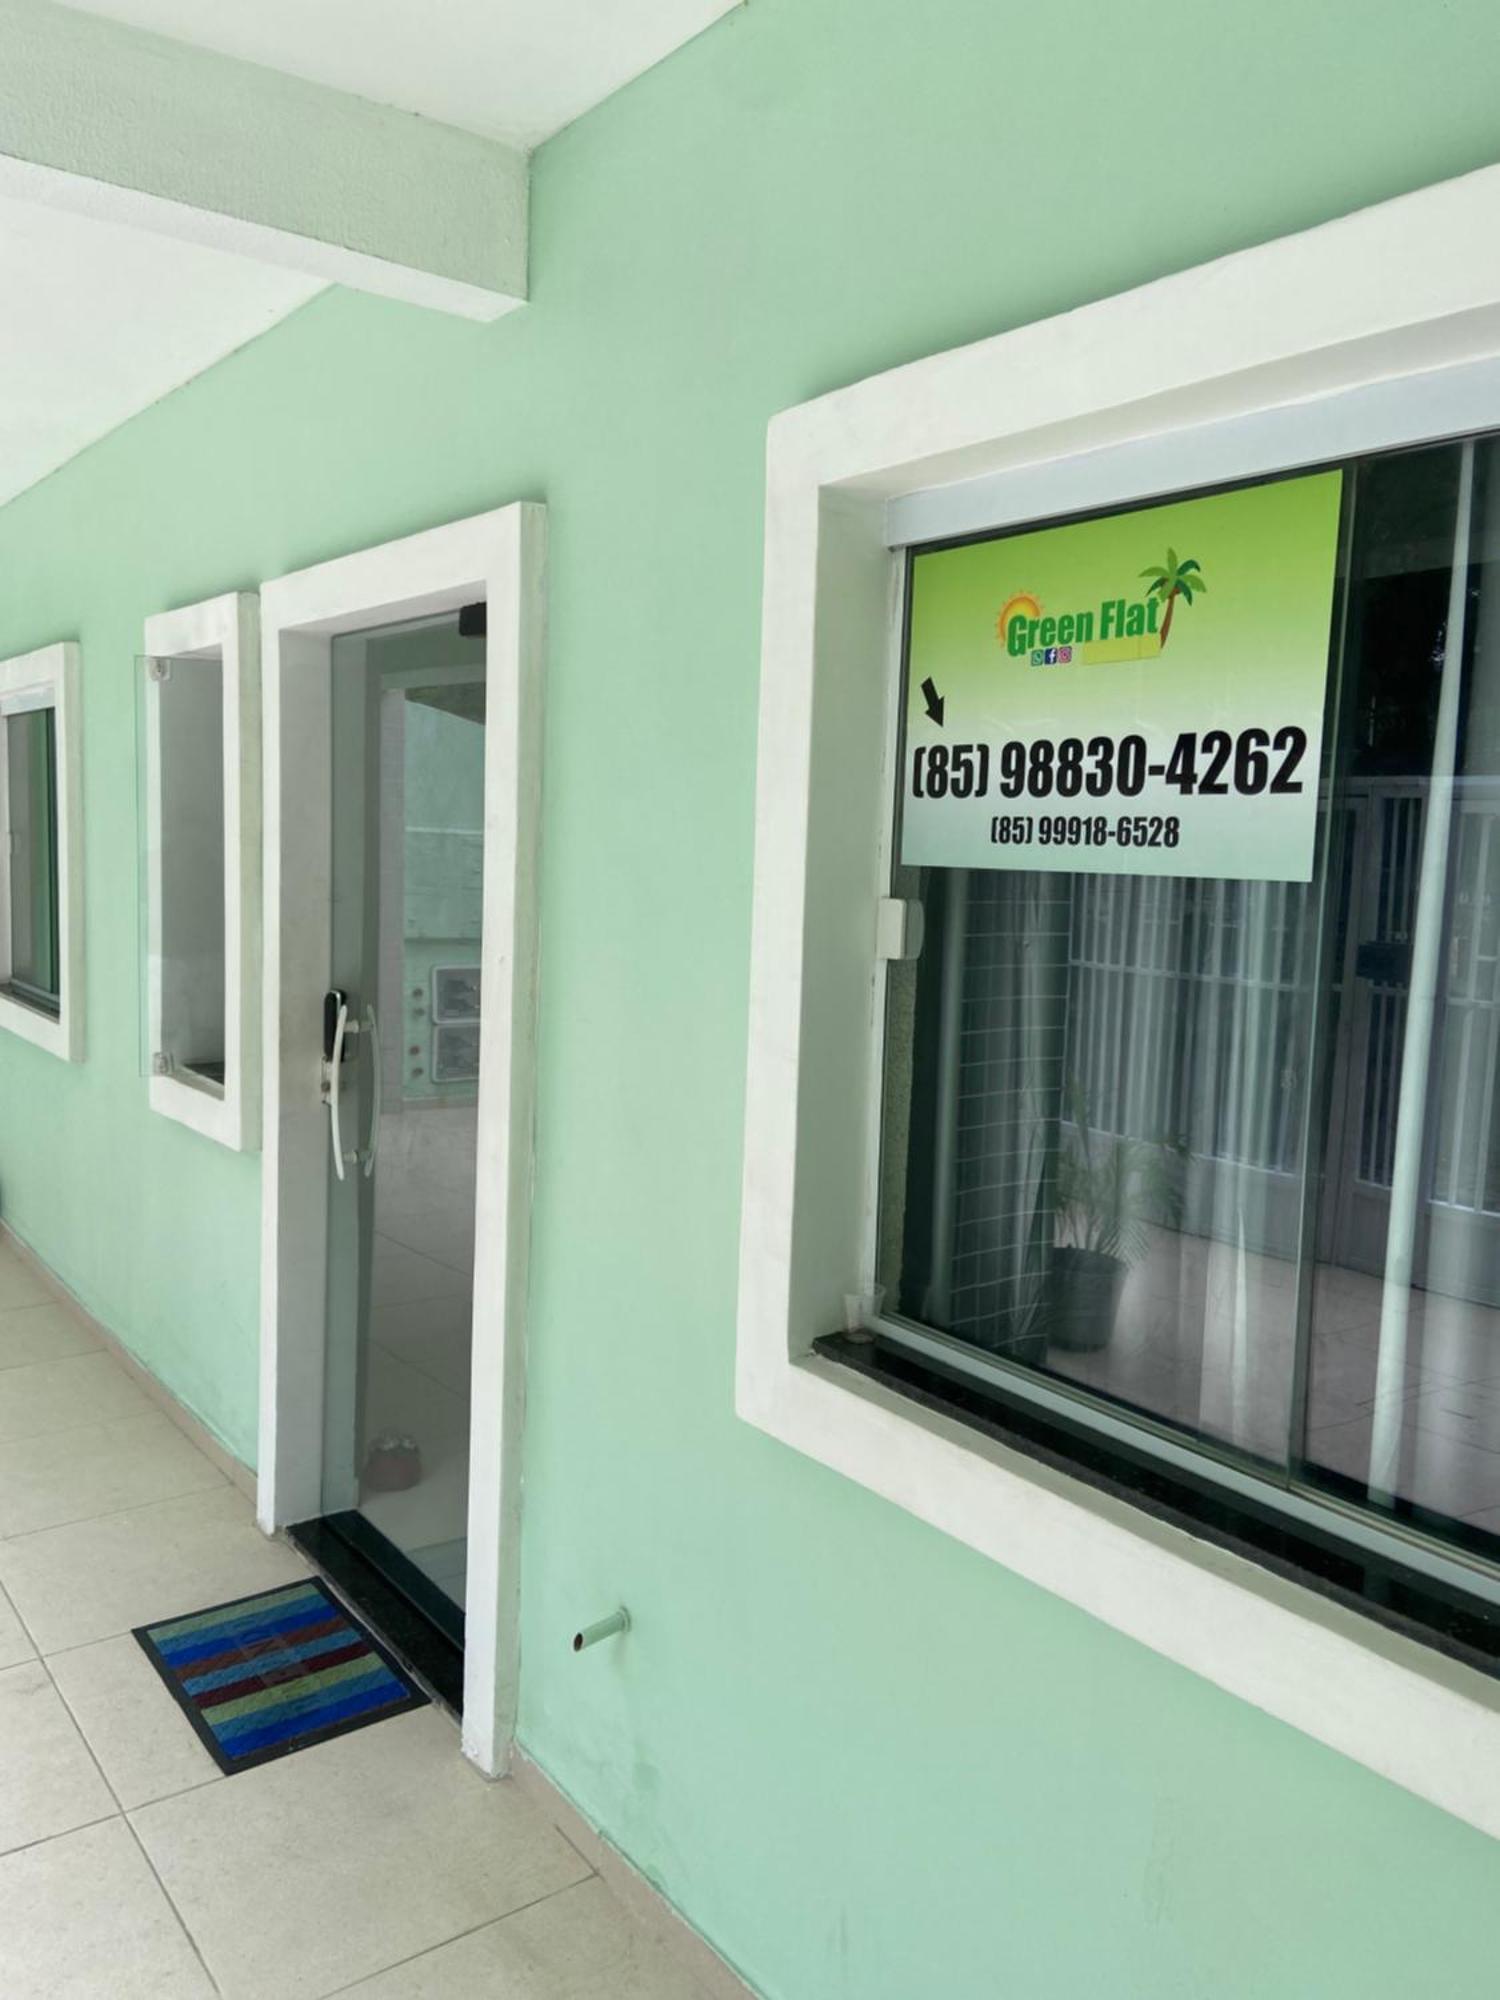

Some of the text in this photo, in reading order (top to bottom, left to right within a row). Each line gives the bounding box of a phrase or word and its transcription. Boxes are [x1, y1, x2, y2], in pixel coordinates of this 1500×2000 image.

[1007, 597, 1160, 657] Green Flat
[912, 726, 1307, 799] (85) 98830-4262
[991, 816, 1180, 848] (85) 99918-6528
